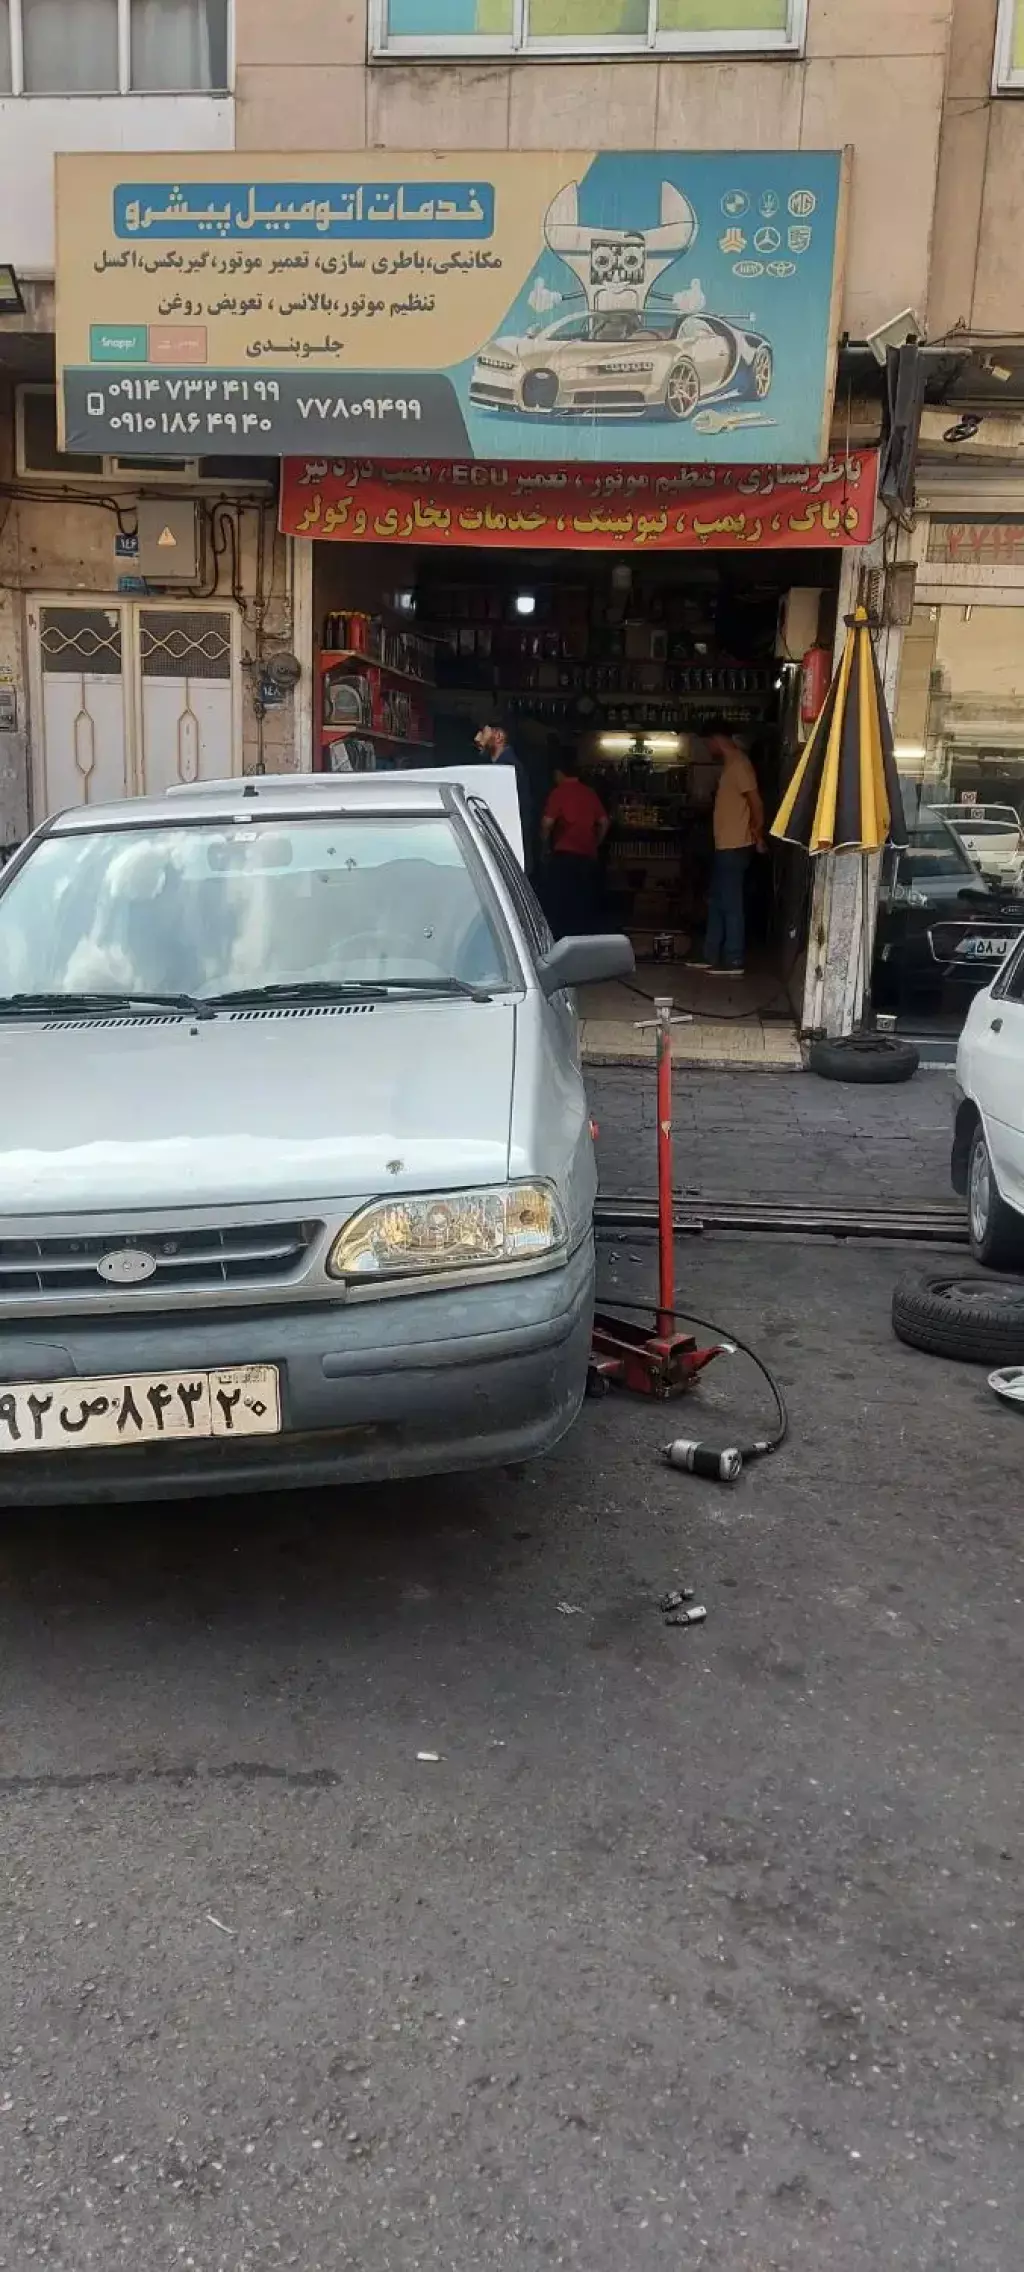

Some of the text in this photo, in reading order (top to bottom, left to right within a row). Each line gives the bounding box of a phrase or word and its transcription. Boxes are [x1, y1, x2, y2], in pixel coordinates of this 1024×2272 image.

[125, 185, 485, 238] خدمات اتومبیل پیشرو
[267, 251, 310, 275] تعمیر
[158, 292, 203, 316] روغن
[207, 293, 263, 316] تعویض
[390, 292, 437, 318] تنظیم
[296, 397, 422, 420] ۷۷۸۰۹۴۹۹
[452, 464, 509, 487] ECU
[511, 468, 568, 496] تعمیر
[589, 467, 649, 497] موتور
[655, 465, 716, 496] تنظیم
[374, 498, 451, 536] بخاری
[459, 503, 548, 531] خدمات
[573, 505, 669, 542] تیونینگ
[693, 510, 763, 544] ریمپ
[789, 500, 859, 537] دیاگ
